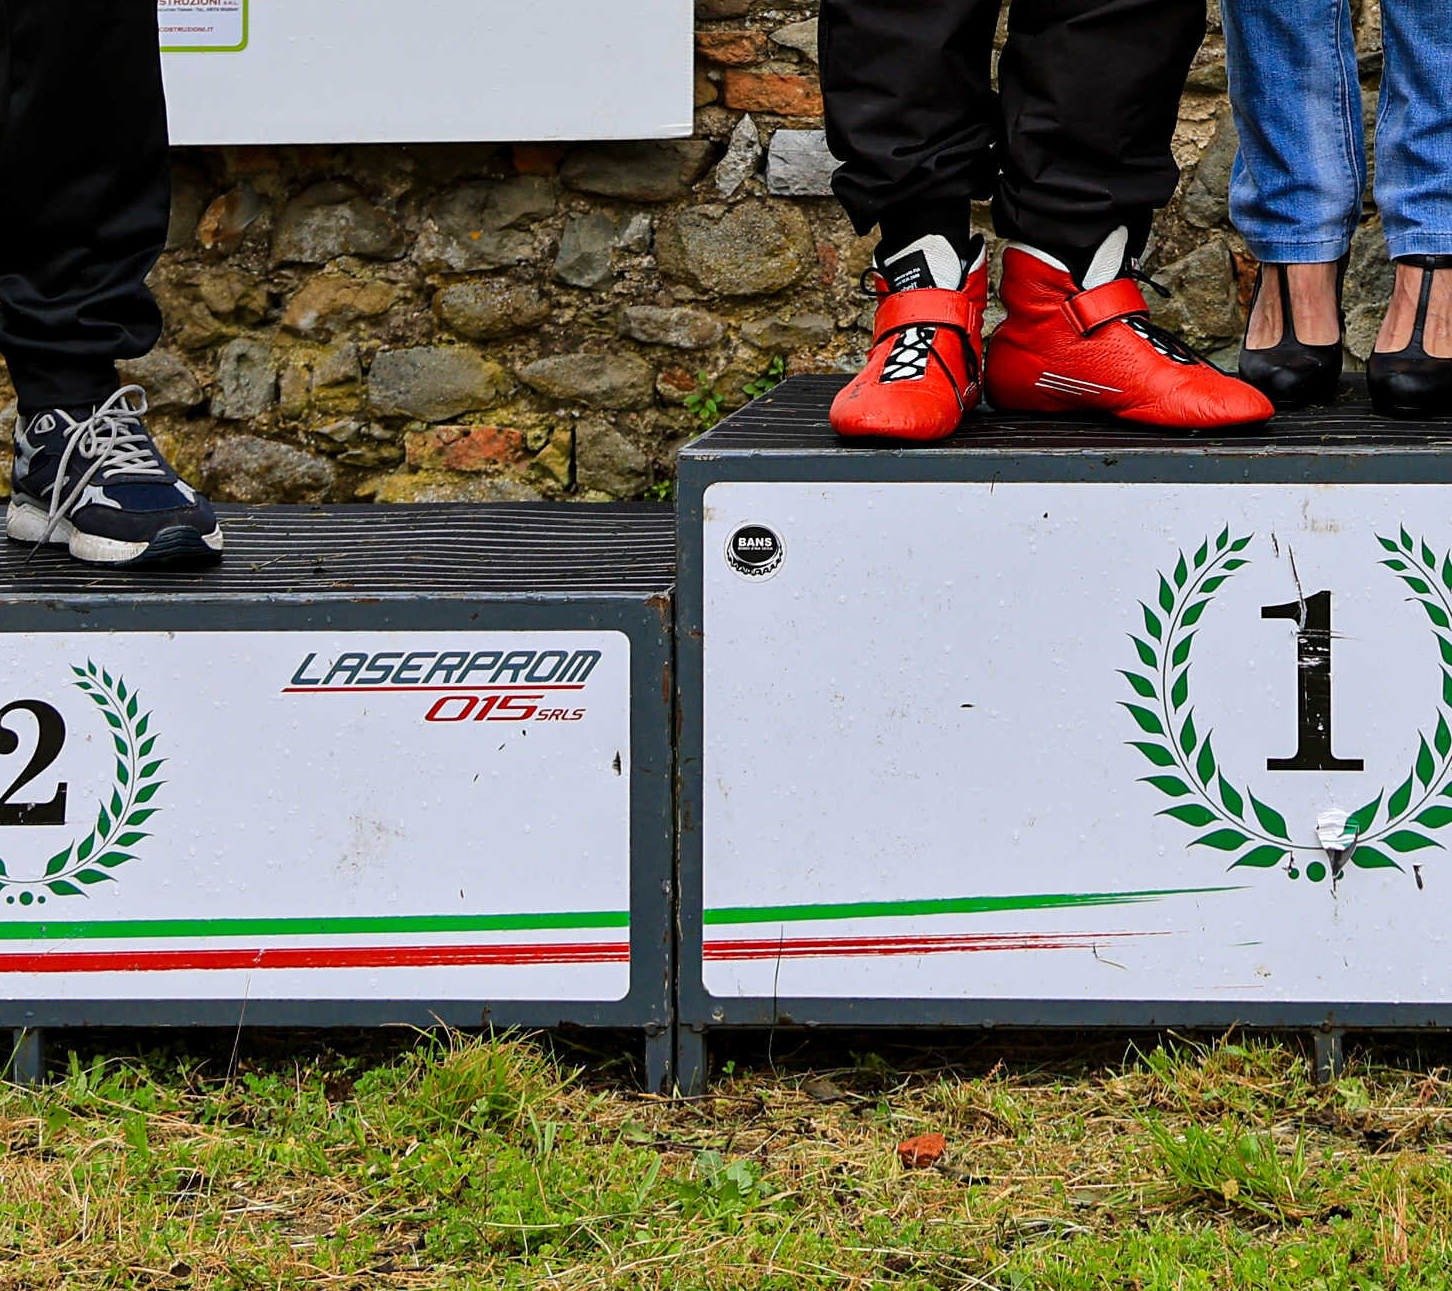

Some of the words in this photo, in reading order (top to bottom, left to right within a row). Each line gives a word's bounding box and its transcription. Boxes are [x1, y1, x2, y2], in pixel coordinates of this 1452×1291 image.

[738, 538, 772, 546] BANS
[289, 650, 603, 686] LASERPROM
[1259, 590, 1364, 772] 1
[536, 707, 585, 722] SRLS
